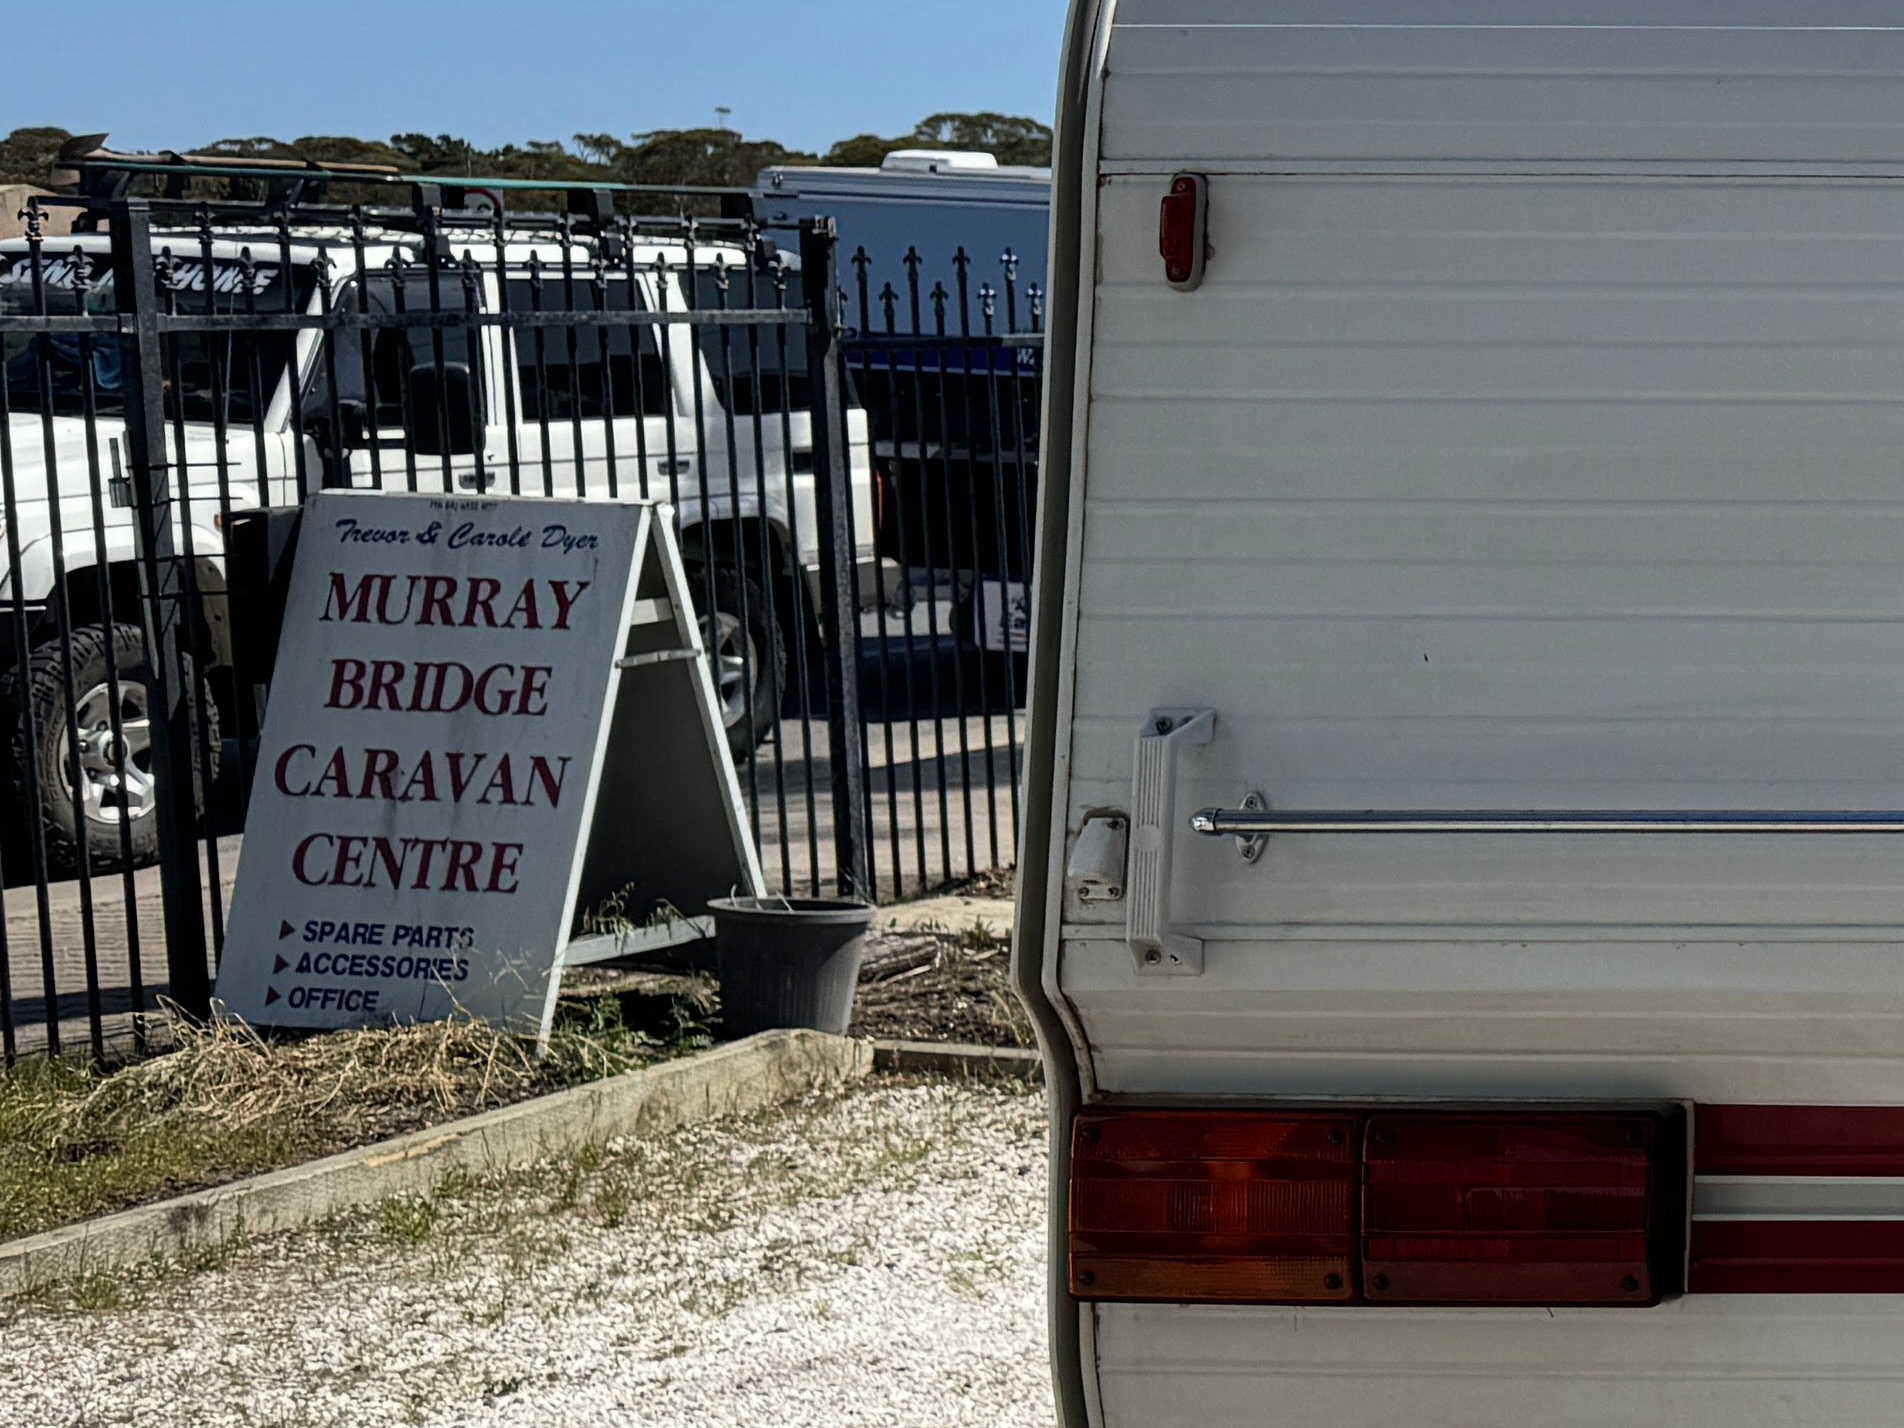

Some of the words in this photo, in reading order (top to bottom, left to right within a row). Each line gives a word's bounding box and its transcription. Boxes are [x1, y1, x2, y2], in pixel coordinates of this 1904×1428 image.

[336, 518, 410, 544] Trevor
[414, 521, 443, 545] &
[541, 524, 600, 555] Dyer
[319, 571, 591, 631] MURRAY
[323, 658, 553, 717] BRIDGE
[274, 743, 574, 810] CARAVAN
[291, 832, 524, 894] CENTRE
[303, 920, 385, 946] SPARE
[392, 924, 474, 949] PARTS
[295, 952, 469, 981] ACCESSORIES
[288, 986, 380, 1012] OFFICE
